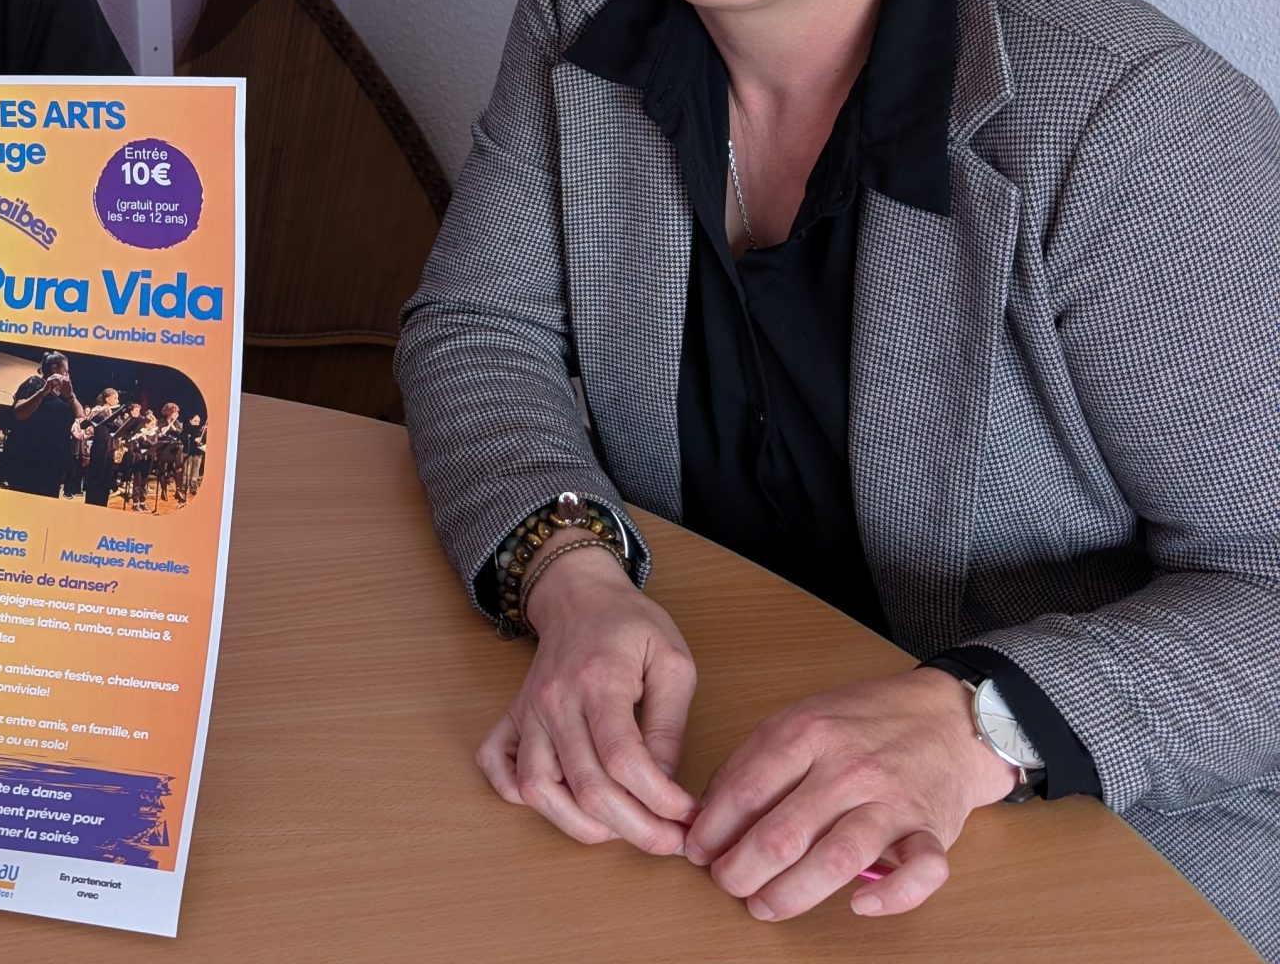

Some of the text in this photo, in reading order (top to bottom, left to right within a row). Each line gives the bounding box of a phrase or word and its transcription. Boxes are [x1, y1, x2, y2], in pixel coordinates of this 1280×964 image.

[43, 101, 125, 130] ARTS
[125, 147, 168, 160] Entrée
[122, 162, 171, 185] 10€
[117, 199, 179, 212] (gratuit pour
[108, 211, 122, 221] les
[133, 212, 145, 222] de
[150, 212, 161, 223] 12
[165, 213, 187, 227] ans)
[102, 270, 223, 320] Vida
[32, 322, 88, 339] Rumba
[93, 325, 156, 343] Cumbia
[160, 329, 205, 346] Salsa
[97, 536, 153, 554] Atelier
[60, 550, 189, 574] Musiques Actuelles
[37, 573, 56, 586] de
[59, 575, 118, 593] danser?
[77, 603, 104, 614] pour
[106, 606, 128, 617] une
[130, 608, 164, 620] soirée
[167, 613, 189, 623] aux
[37, 618, 71, 631] latino,
[74, 623, 114, 636] rumba,
[117, 628, 161, 640] cumbia
[162, 631, 171, 641] &
[5, 664, 62, 679] ambiance
[64, 669, 104, 685] festive,
[107, 674, 179, 692] chaleureuse
[6, 716, 36, 727] entre
[38, 719, 69, 732] amis,
[72, 724, 86, 733] en
[89, 723, 131, 739] famille,
[134, 730, 148, 739] en
[7, 737, 22, 745] ou
[24, 739, 38, 747] en
[41, 740, 68, 750] solo!
[12, 785, 30, 795] de
[32, 786, 72, 801] danse
[25, 808, 71, 821] prévue
[72, 814, 105, 826] pour
[24, 828, 36, 840] la
[40, 831, 79, 845] soirée
[60, 873, 122, 889] En partenariat
[77, 891, 99, 900] avec
